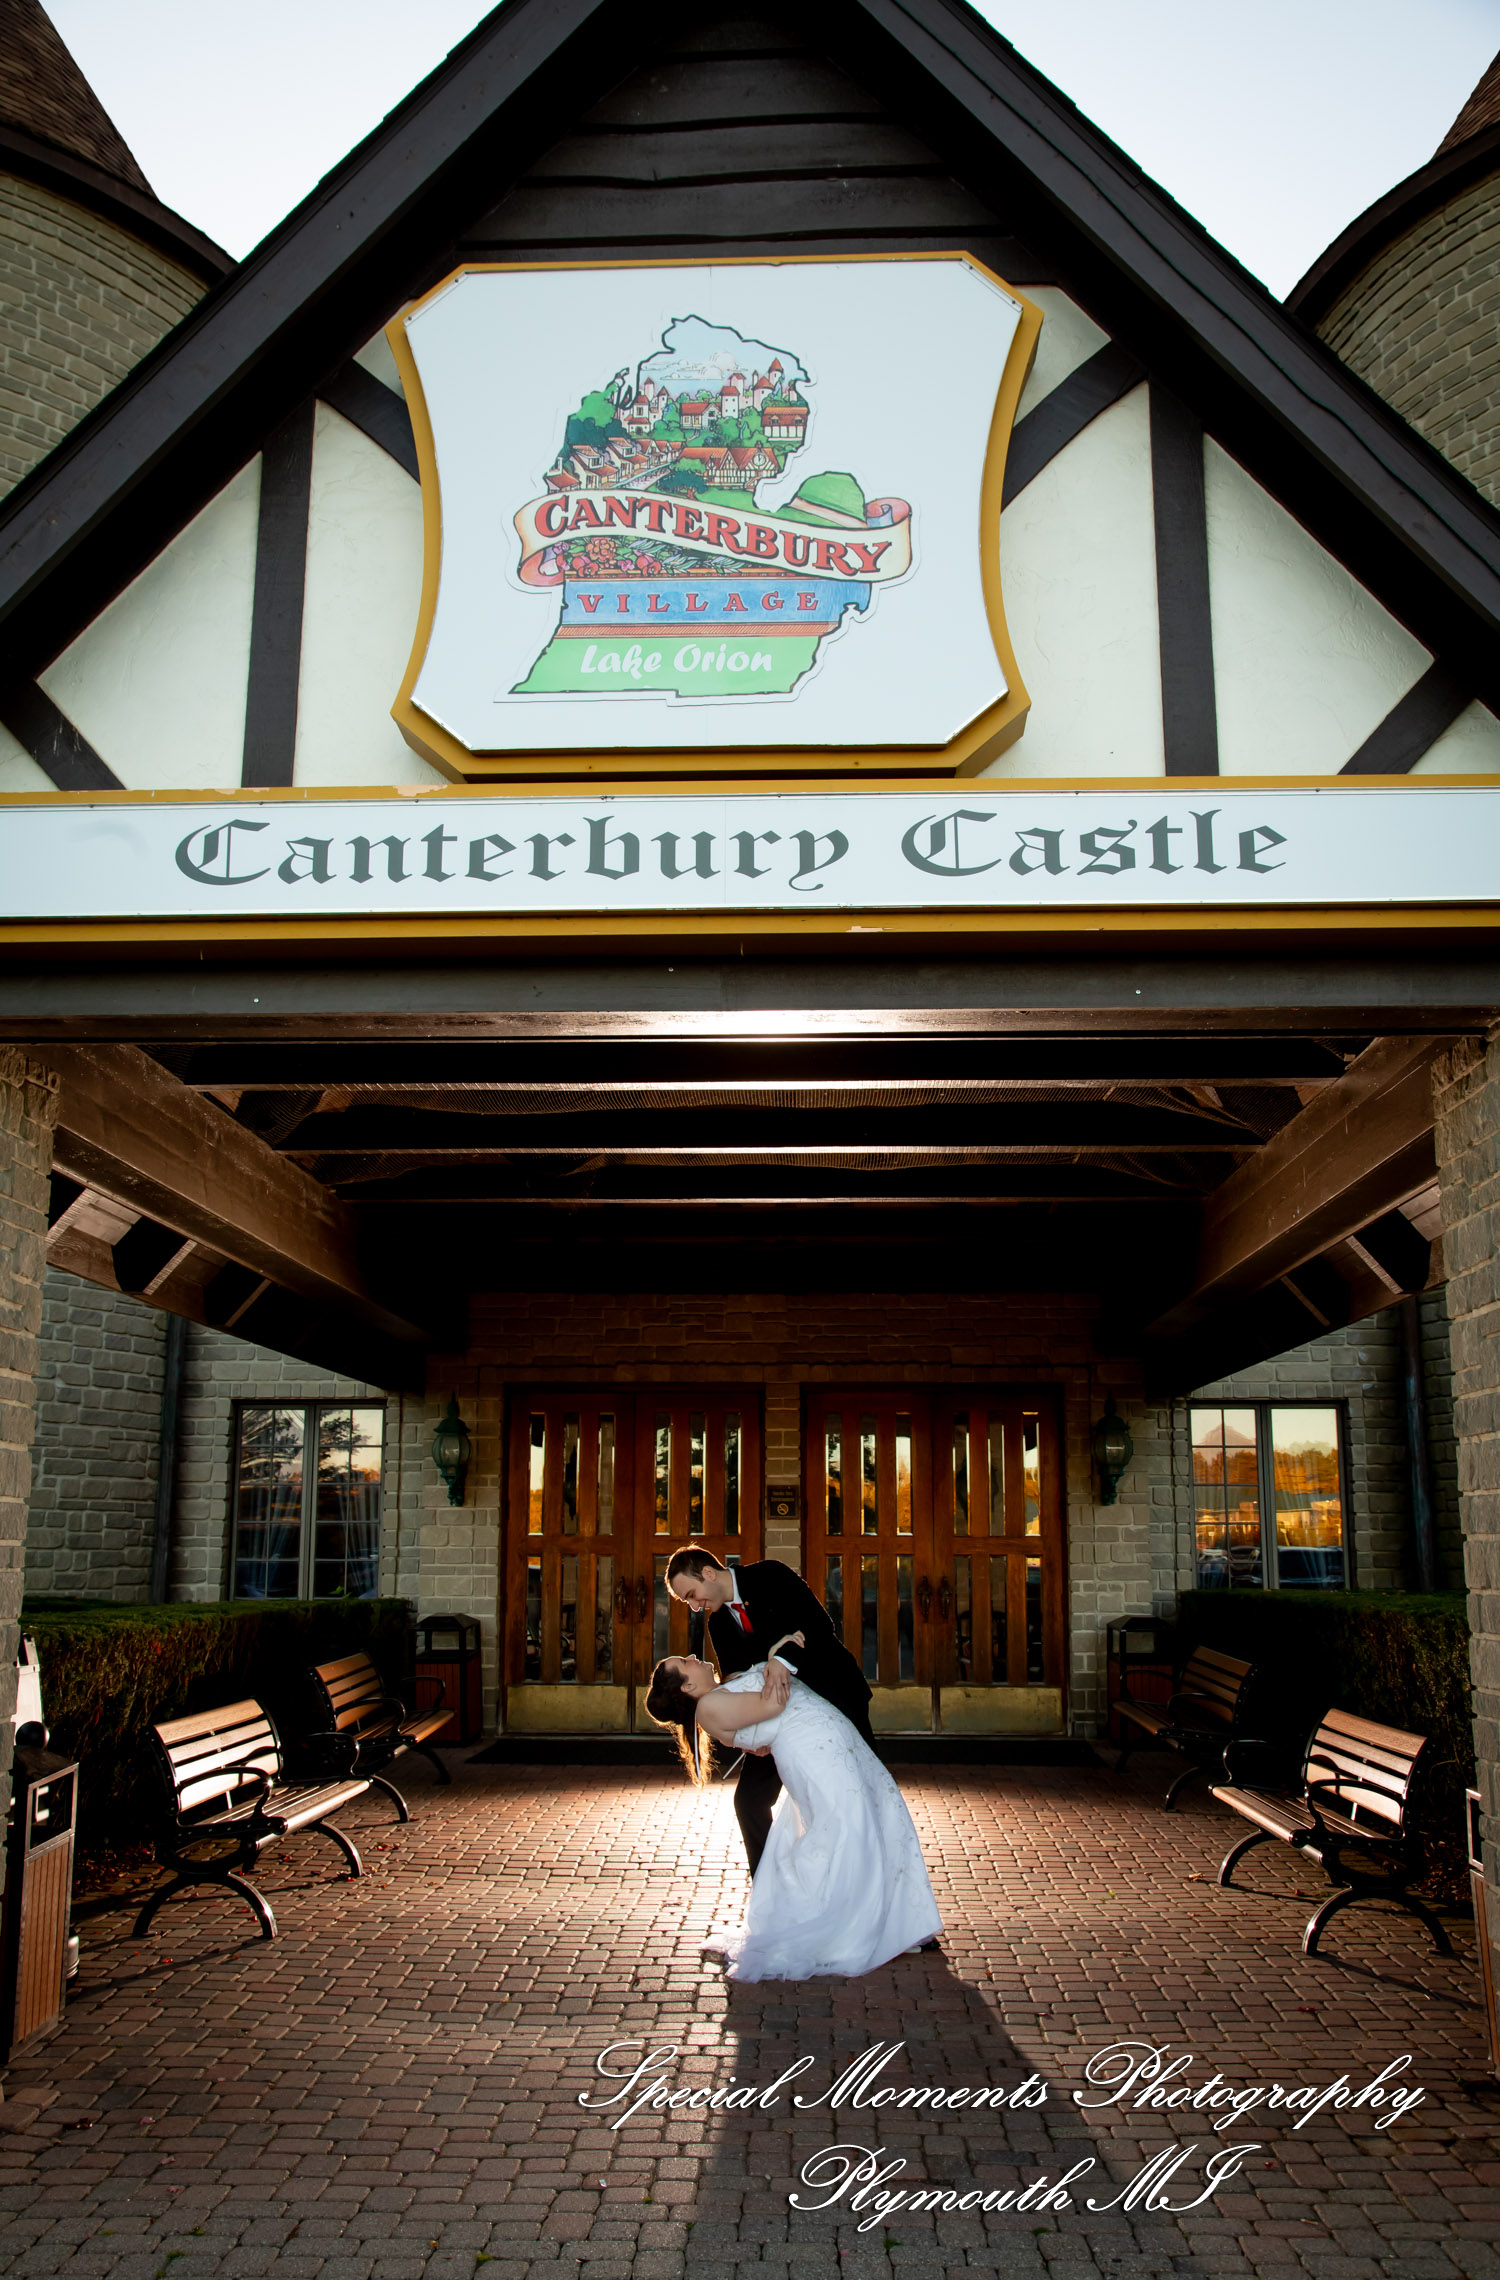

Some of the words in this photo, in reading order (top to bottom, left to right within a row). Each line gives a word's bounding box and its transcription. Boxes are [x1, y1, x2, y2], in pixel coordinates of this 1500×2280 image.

[535, 496, 891, 575] CANTERBURY
[577, 592, 818, 612] VILLAGE
[581, 645, 661, 678] Lake
[673, 644, 773, 673] Orion
[175, 815, 850, 891] Canterbury
[901, 809, 1287, 876] Castle
